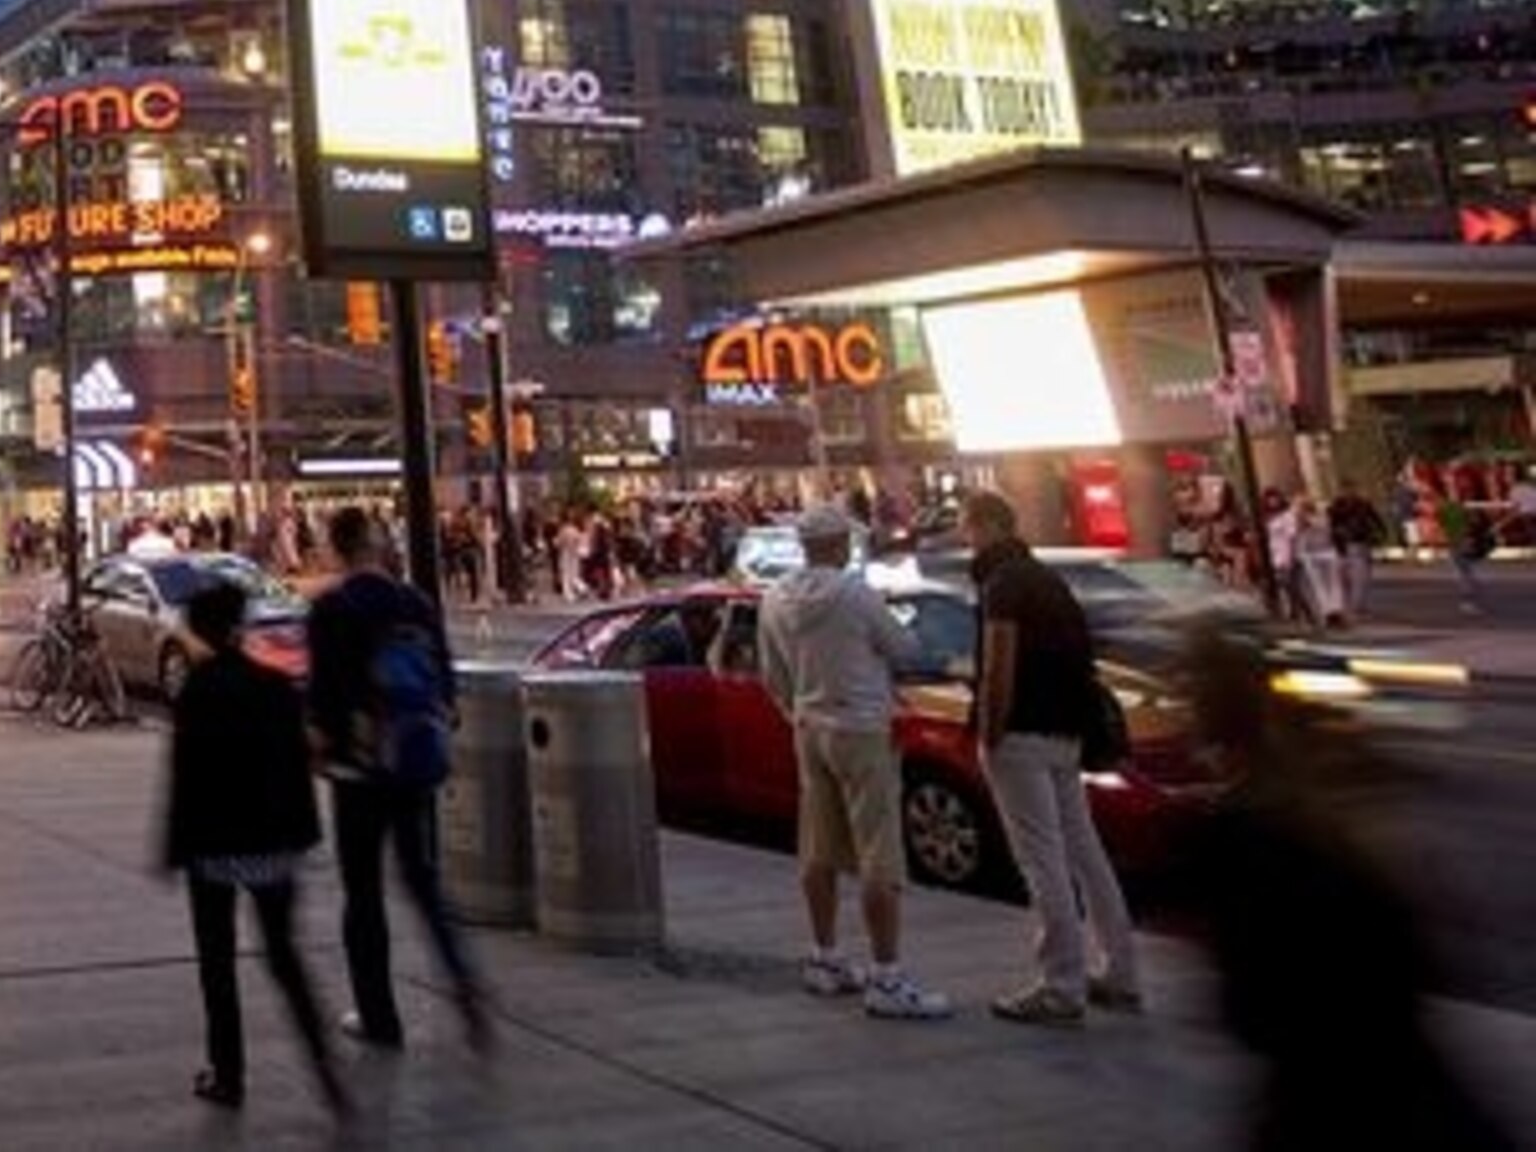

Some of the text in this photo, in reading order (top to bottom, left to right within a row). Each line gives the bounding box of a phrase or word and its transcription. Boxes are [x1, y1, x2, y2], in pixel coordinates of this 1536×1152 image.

[895, 69, 974, 134] BOOK
[332, 165, 408, 192] Dundas
[17, 193, 222, 244] FUURE SHOP
[703, 321, 882, 386] amc
[706, 382, 781, 405] IMAX
